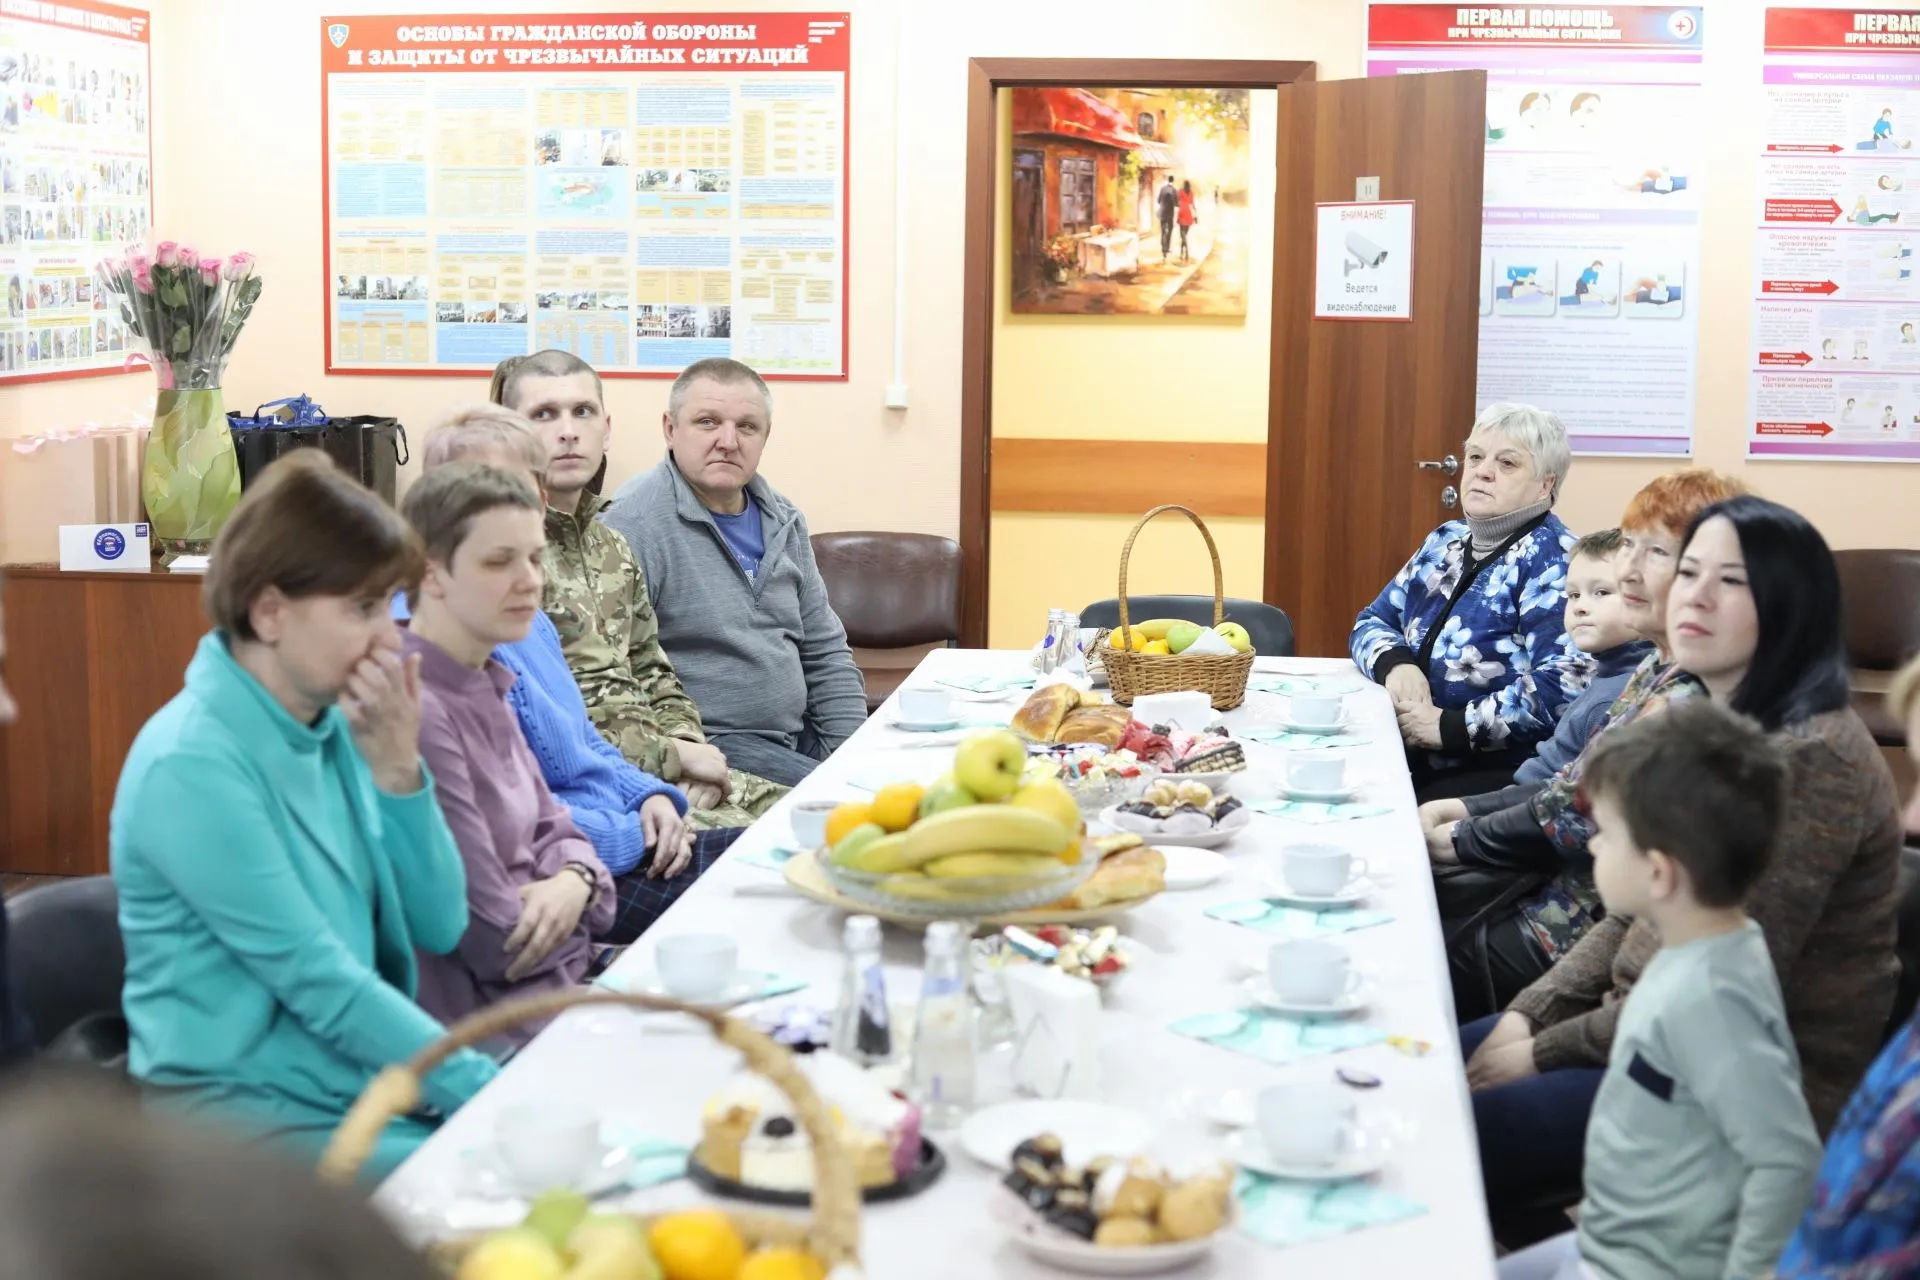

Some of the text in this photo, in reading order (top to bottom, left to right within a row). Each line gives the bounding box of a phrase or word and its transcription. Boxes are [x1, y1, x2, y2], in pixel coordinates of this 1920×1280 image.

[1456, 9, 1614, 28] ПЕРВАЯ ПОМОЩЬ
[397, 21, 757, 44] ОСНОВЫ ГРАЖДАНСКОЙ ОБОРОНЫ
[1447, 28, 1469, 38] ПРИ
[1845, 33, 1867, 43] ПРИ
[347, 44, 809, 68] И ЗАЩИТЫ ОТ ЧРЕЗВЫЧАЙНЫХ СИТУАЦИЙ
[1341, 209, 1387, 221] ВНИМАНИЕ!
[1345, 282, 1379, 294] Ведется
[1326, 302, 1397, 313] видеонаблюдение
